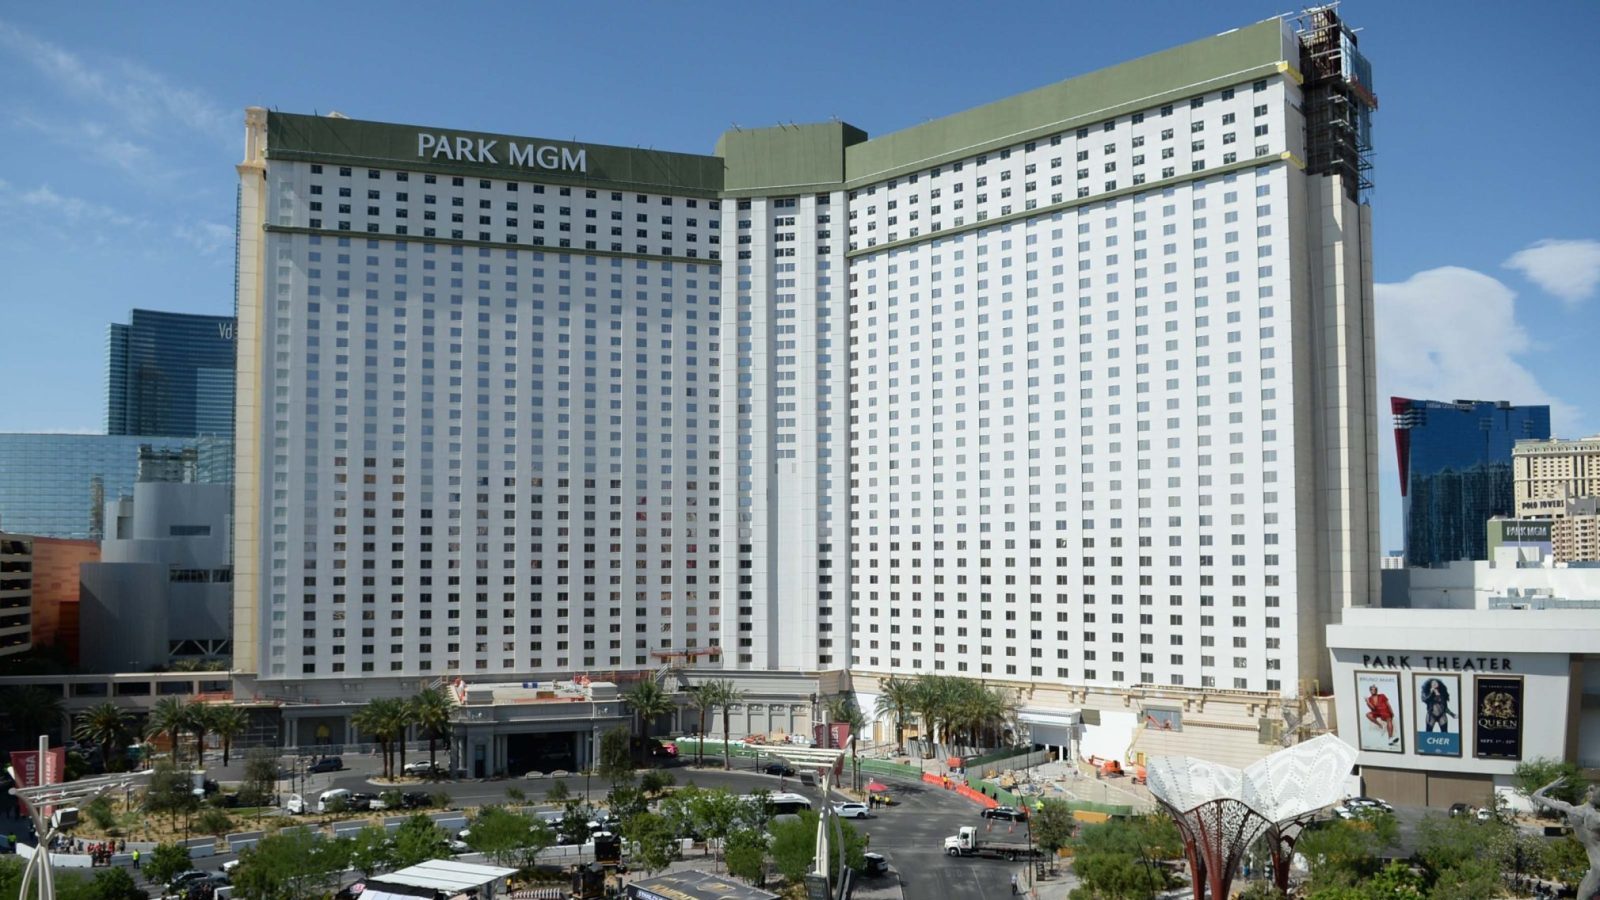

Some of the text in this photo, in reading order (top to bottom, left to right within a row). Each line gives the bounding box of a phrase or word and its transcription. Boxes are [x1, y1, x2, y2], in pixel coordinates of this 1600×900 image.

[417, 133, 587, 173] PARK MGM
[218, 322, 233, 340] Vd
[1522, 500, 1564, 509] POLO TOWERS
[1506, 526, 1547, 536] PARK MGM
[1363, 654, 1512, 670] PARK THEATER
[1478, 719, 1518, 729] QUEEN
[1426, 736, 1450, 745] CHER
[26, 755, 36, 787] HIBA
